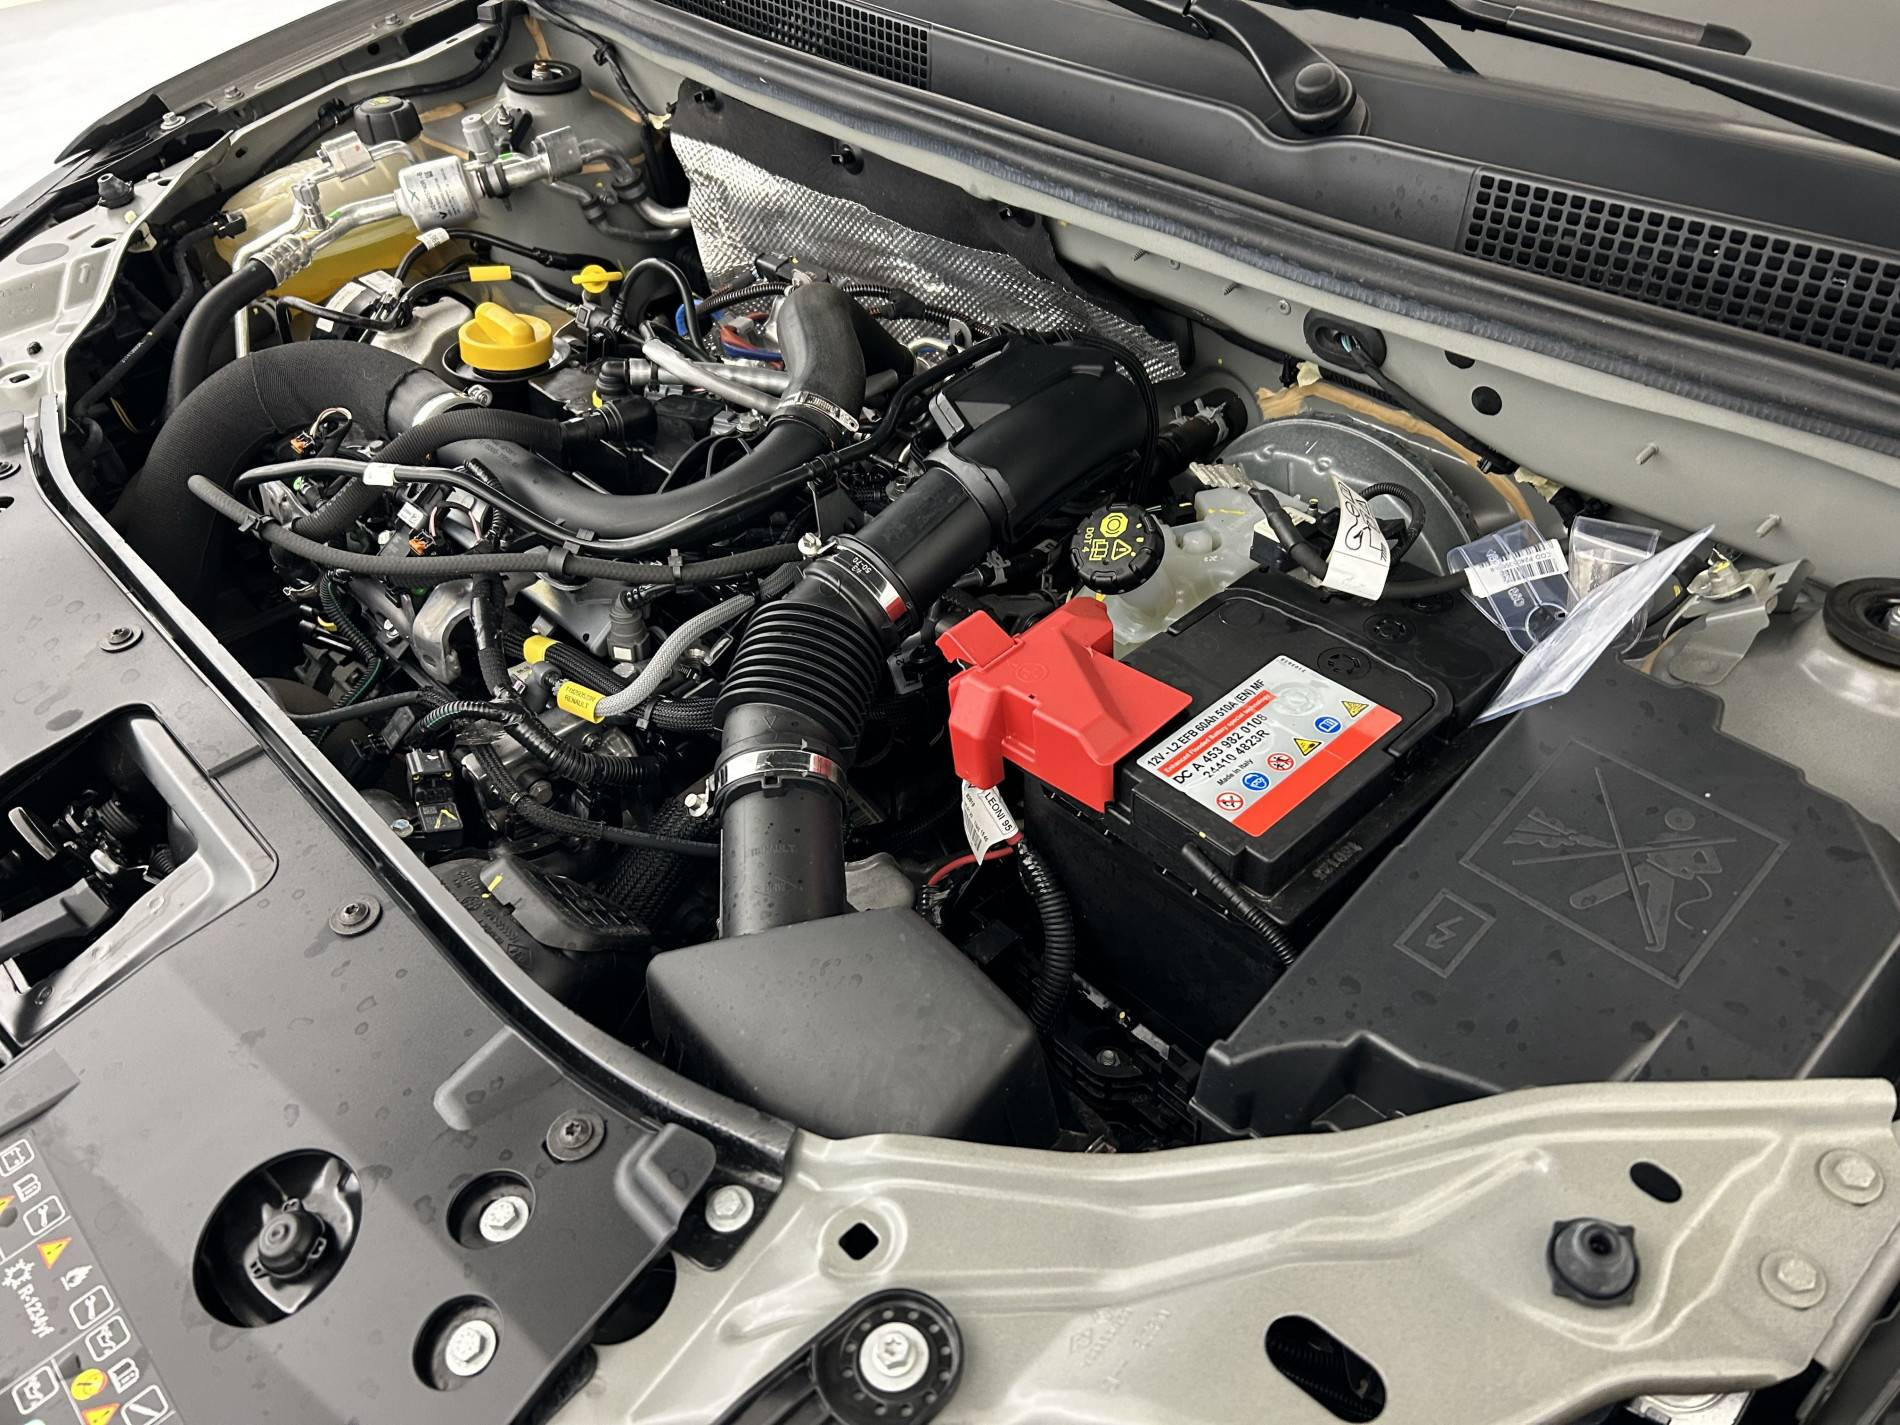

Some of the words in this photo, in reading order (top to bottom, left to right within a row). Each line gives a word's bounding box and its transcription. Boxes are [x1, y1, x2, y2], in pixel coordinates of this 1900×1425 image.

[1084, 527, 1094, 544] DOT
[852, 557, 871, 573] 50-70
[564, 694, 589, 708] RENAULT
[1147, 752, 1165, 767] 12V
[1167, 741, 1181, 753] L2
[1180, 730, 1198, 744] EFB
[1195, 714, 1219, 731] 60Ah
[1215, 700, 1238, 717] 510A
[1234, 688, 1256, 703] (EN)
[1253, 678, 1265, 691] MF
[1164, 752, 1191, 772] Enhanced
[1208, 725, 1229, 740] Battery
[1226, 713, 1244, 728] special
[1173, 769, 1193, 784] DC
[1192, 762, 1206, 772] A
[1202, 746, 1223, 763] 453
[1221, 732, 1244, 748] 982
[1240, 713, 1268, 733] 0108
[1203, 754, 1237, 778] 24410
[1236, 729, 1270, 754] 4823R
[1217, 773, 1235, 785] Made
[1237, 758, 1254, 770] Italy
[984, 792, 1006, 820] LEONI
[1001, 819, 1013, 831] 95
[18, 1283, 55, 1338] R-1234yf
